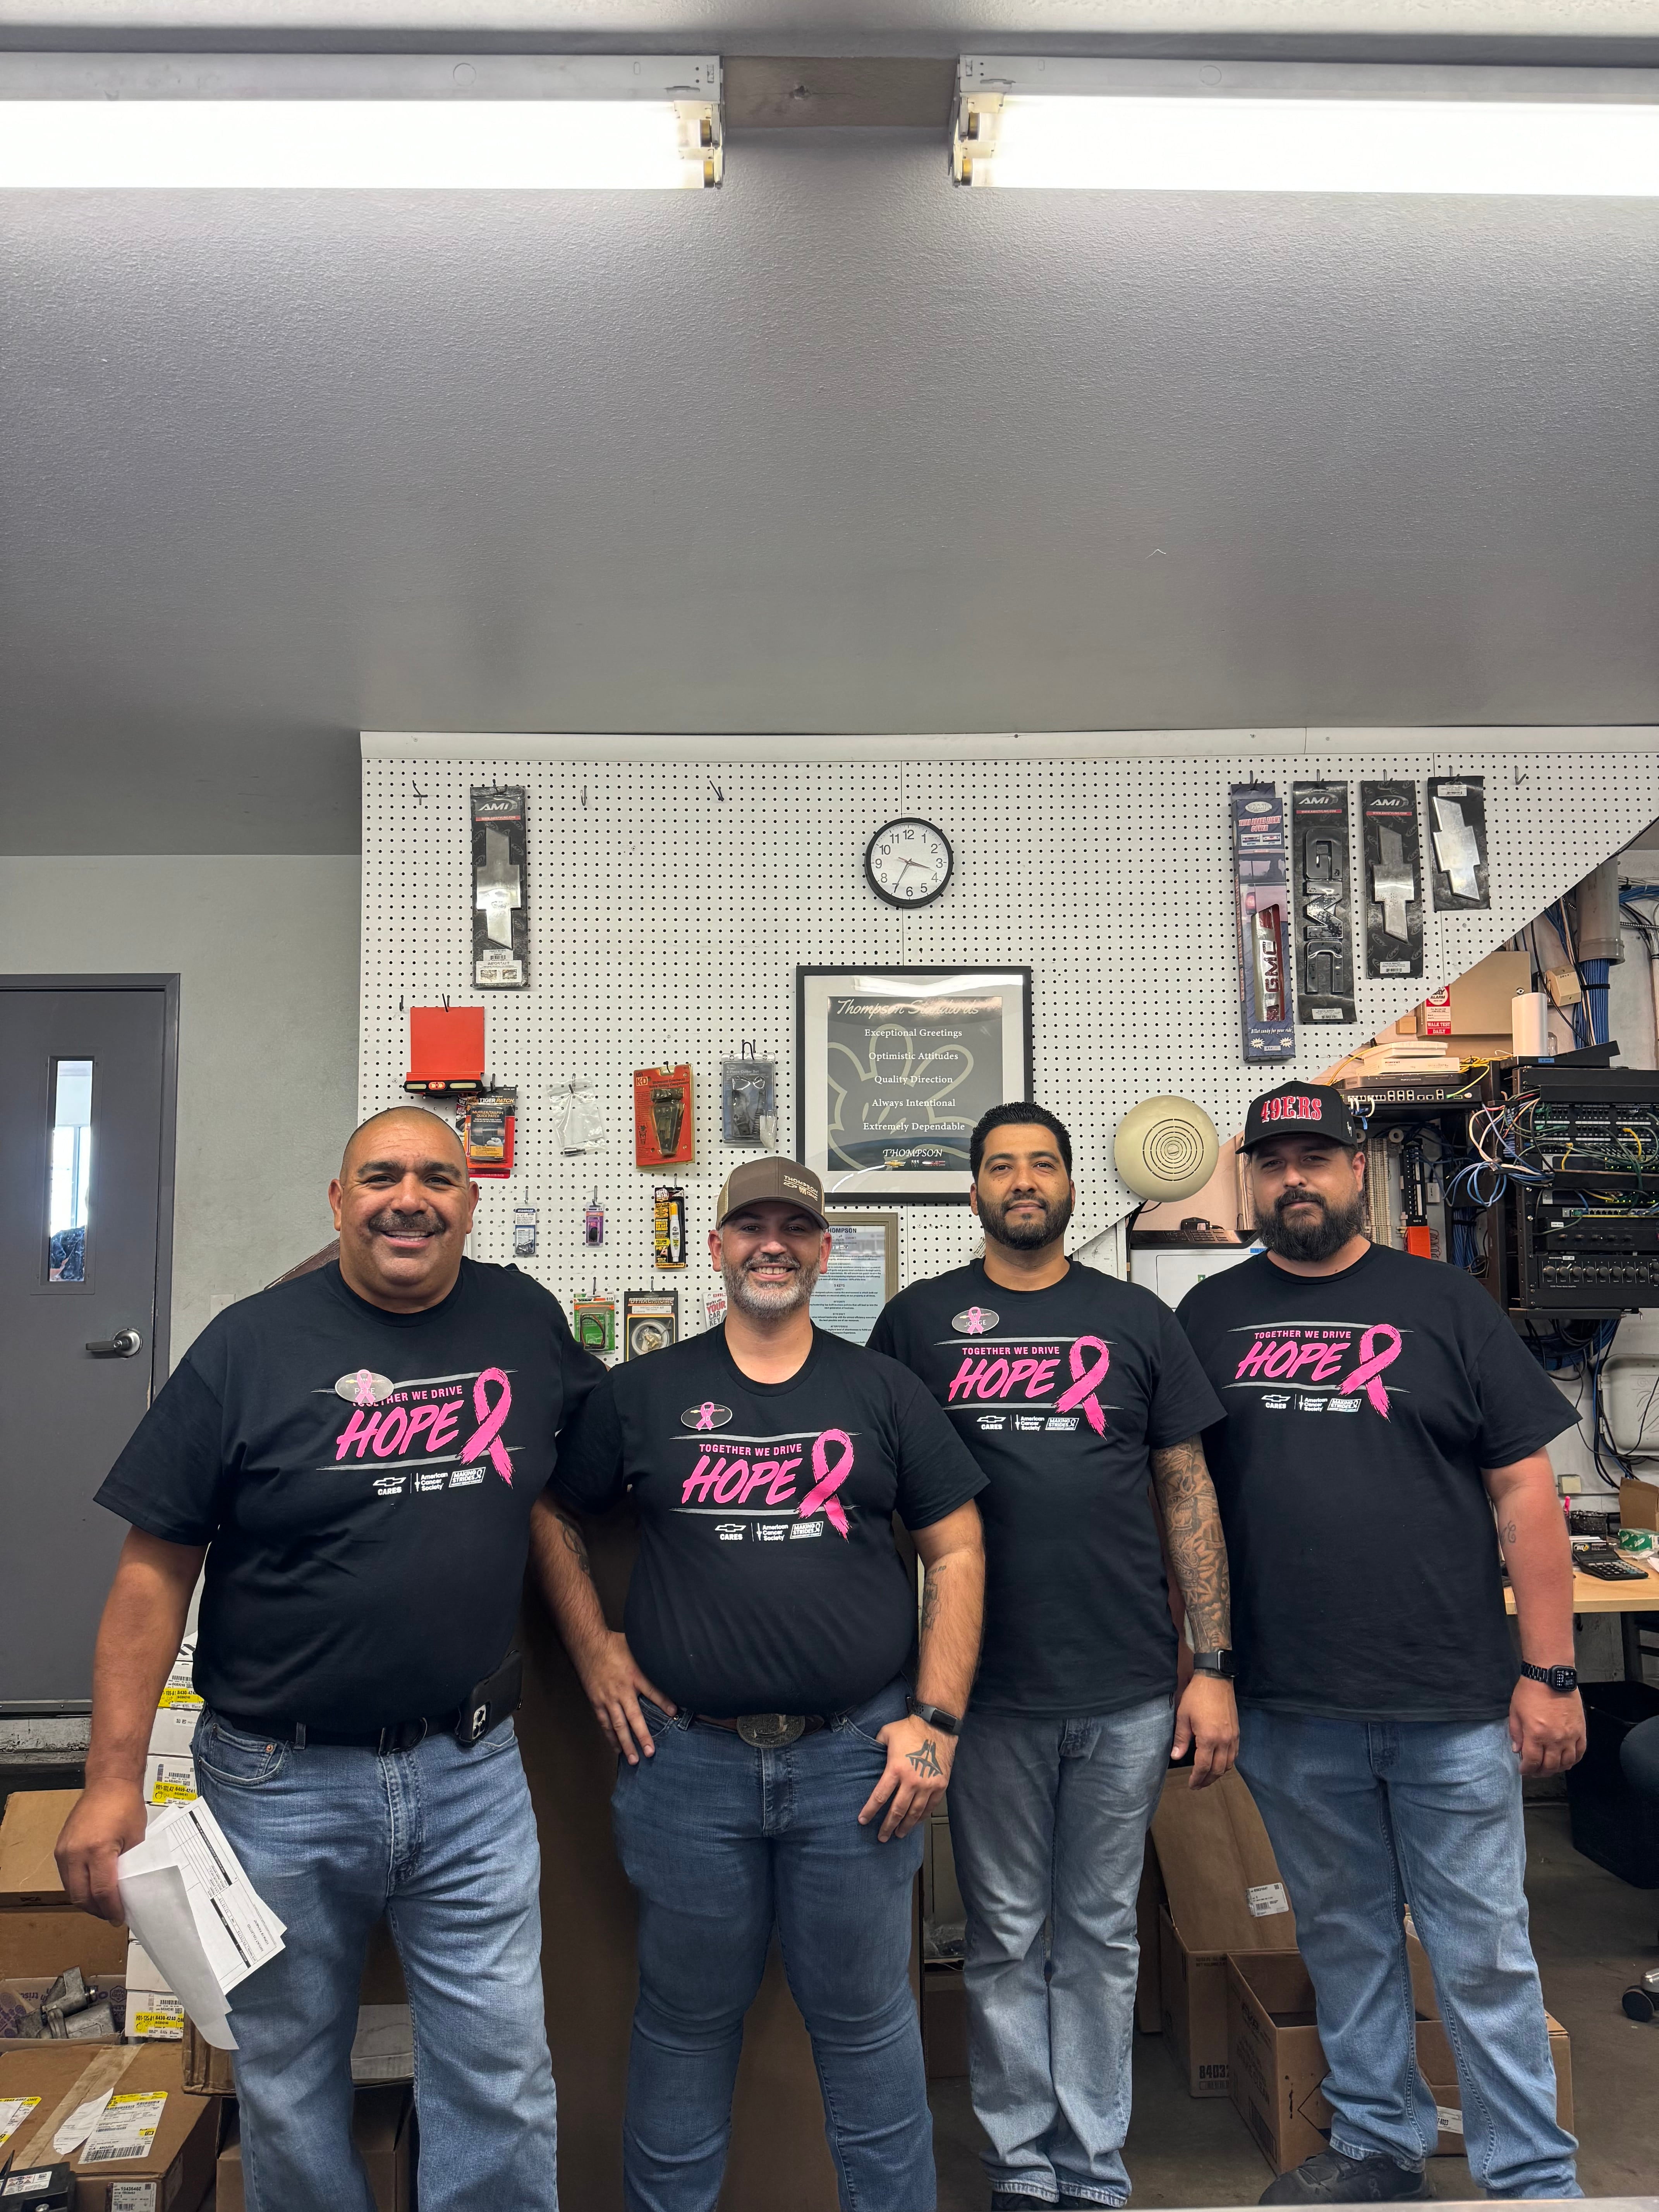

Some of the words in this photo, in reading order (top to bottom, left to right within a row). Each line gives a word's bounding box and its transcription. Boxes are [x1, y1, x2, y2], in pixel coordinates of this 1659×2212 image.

[477, 803, 509, 811] AMI
[890, 833, 899, 843] 11
[903, 830, 914, 840] 12
[922, 833, 926, 843] 1
[879, 845, 891, 855] 10
[931, 843, 938, 854] 2
[875, 858, 882, 869] 9
[936, 858, 943, 868] 3
[881, 872, 888, 883] 8
[931, 872, 938, 883] 4
[892, 883, 899, 893] 7
[906, 886, 913, 896] 6
[921, 883, 927, 893] 5
[1306, 828, 1344, 994] GMC
[1262, 941, 1279, 992] GMC
[837, 999, 904, 1019] Thompson
[864, 1029, 917, 1038] Exceptional
[919, 1029, 962, 1038] Greetings
[869, 1052, 915, 1061] Optimistic
[917, 1052, 958, 1060] Attitudes
[874, 1075, 908, 1085] Quality
[910, 1075, 953, 1084] Direction
[872, 1099, 903, 1108] Always
[906, 1099, 956, 1107] Intentional
[1261, 1096, 1322, 1123] 49ERS
[863, 1122, 909, 1132] Extremely
[912, 1122, 965, 1132] Dependable
[883, 1149, 943, 1158] THOMPSON
[784, 1175, 818, 1194] THOMPSON
[706, 1300, 726, 1314] YOUR
[709, 1310, 720, 1320] CAR
[709, 1317, 720, 1326] KEY
[964, 1319, 987, 1328] JORGE
[1255, 1330, 1301, 1340] TOGETHER
[1235, 1340, 1351, 1381] HOPE
[948, 1358, 1061, 1402] HOPE
[412, 1390, 428, 1400] WE
[431, 1385, 463, 1399] DRIVE
[336, 1400, 464, 1460] HOPE
[699, 1444, 751, 1456] TOGETHER
[754, 1448, 770, 1456] WE
[773, 1443, 802, 1455] DRIVE
[681, 1455, 803, 1505] HOPE
[378, 1486, 402, 1495] CARES
[421, 1484, 443, 1492] Society
